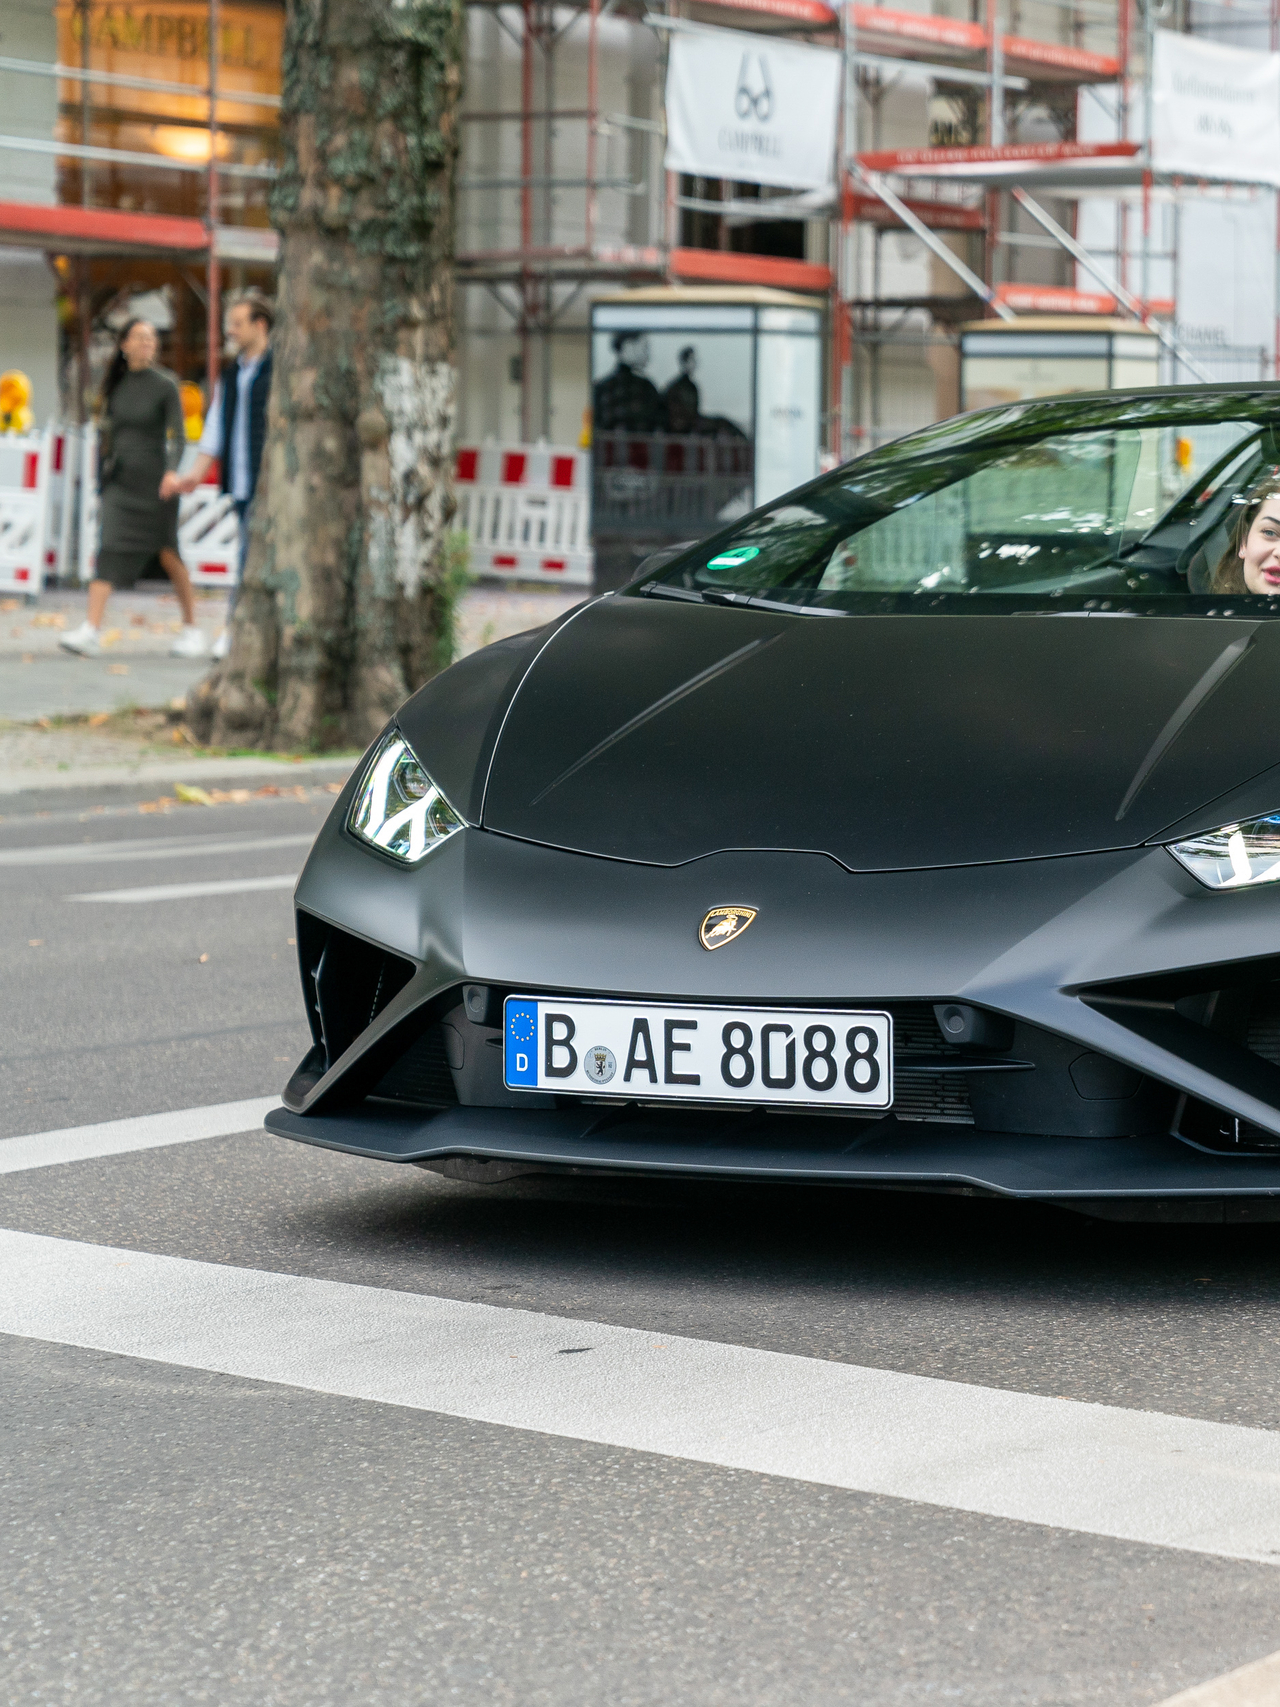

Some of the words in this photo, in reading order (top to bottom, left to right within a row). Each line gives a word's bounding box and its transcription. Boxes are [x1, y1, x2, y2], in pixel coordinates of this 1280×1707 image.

[72, 6, 264, 70] CAMPBLL
[516, 1053, 529, 1072] D
[544, 1012, 578, 1079] B
[622, 1017, 701, 1087] AE
[719, 1020, 881, 1094] 8088
